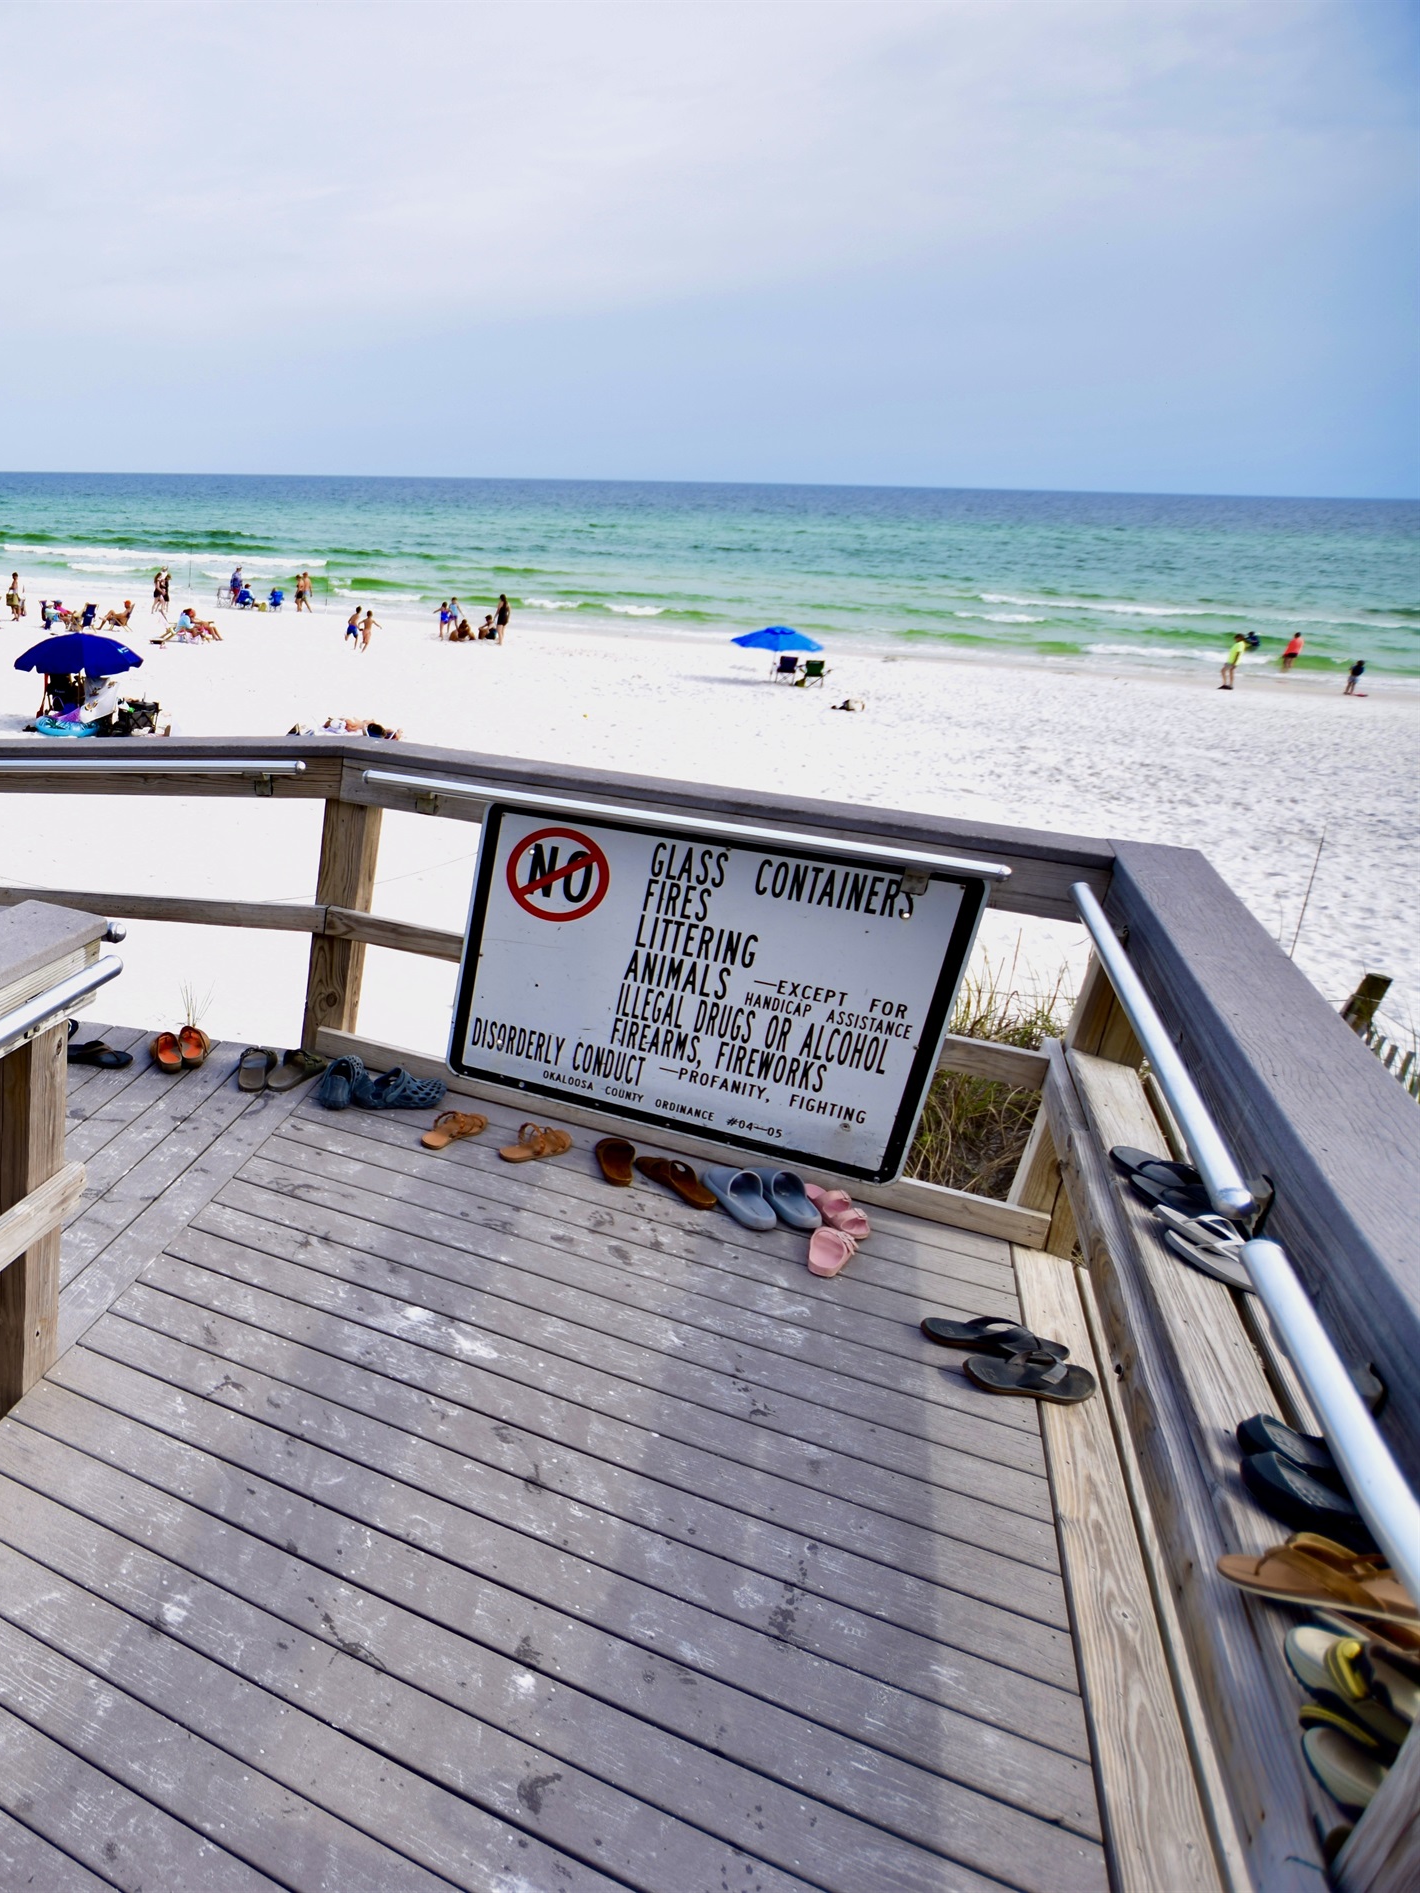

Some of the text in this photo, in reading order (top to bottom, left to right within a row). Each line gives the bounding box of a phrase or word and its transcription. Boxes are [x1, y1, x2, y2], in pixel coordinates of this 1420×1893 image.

[527, 843, 595, 904] NO
[642, 878, 712, 922] FIRES
[651, 842, 915, 919] GLASS CONTAINERS
[635, 914, 758, 969] LITTERING
[623, 949, 731, 1000] ANIMALS
[869, 998, 908, 1019] FOR
[744, 992, 914, 1040] HANDICAP ASSISTANCE
[610, 1017, 827, 1093] FIREARMS, FIREWORKS
[616, 983, 890, 1075] ILLEGAL DRUGS OR ALCOHOL
[471, 1017, 566, 1066] DISORDERLY
[572, 1042, 647, 1086] CONDUCT
[789, 1094, 866, 1124] FIGHTING
[543, 1070, 593, 1091] OKALOOSA
[603, 1086, 644, 1103] COUNTY
[654, 1099, 715, 1121] ORDINANCE
